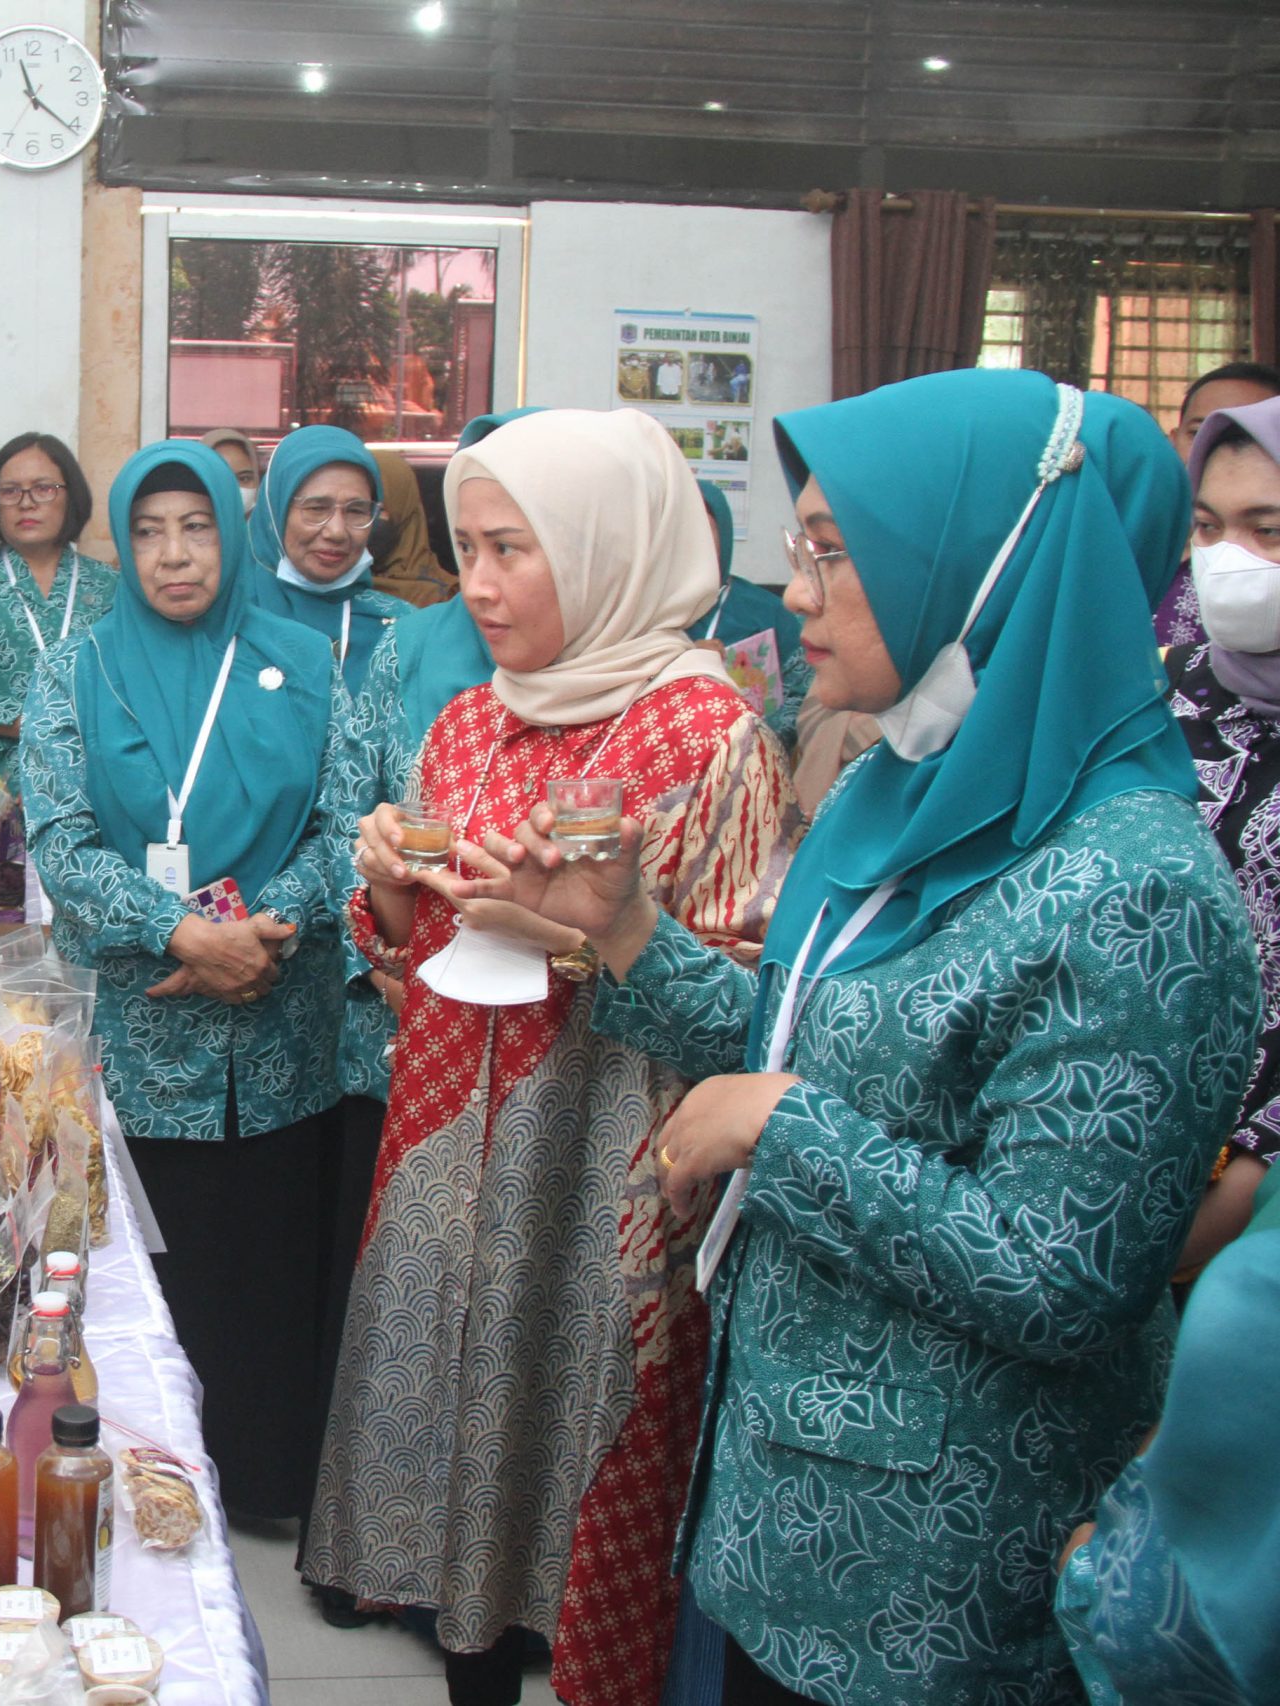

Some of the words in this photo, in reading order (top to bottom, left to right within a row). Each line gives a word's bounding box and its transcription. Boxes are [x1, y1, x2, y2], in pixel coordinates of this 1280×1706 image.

[3, 48, 15, 61] 11
[25, 40, 41, 56] 12
[54, 49, 60, 62] 1
[69, 66, 82, 81] 2
[76, 92, 88, 106] 3
[68, 117, 81, 130] 4
[3, 133, 14, 147] 7
[50, 134, 64, 148] 5
[26, 140, 39, 155] 6
[643, 328, 697, 342] PEMERINTAH
[699, 331, 720, 342] KOTA
[722, 332, 750, 344] BINJAI
